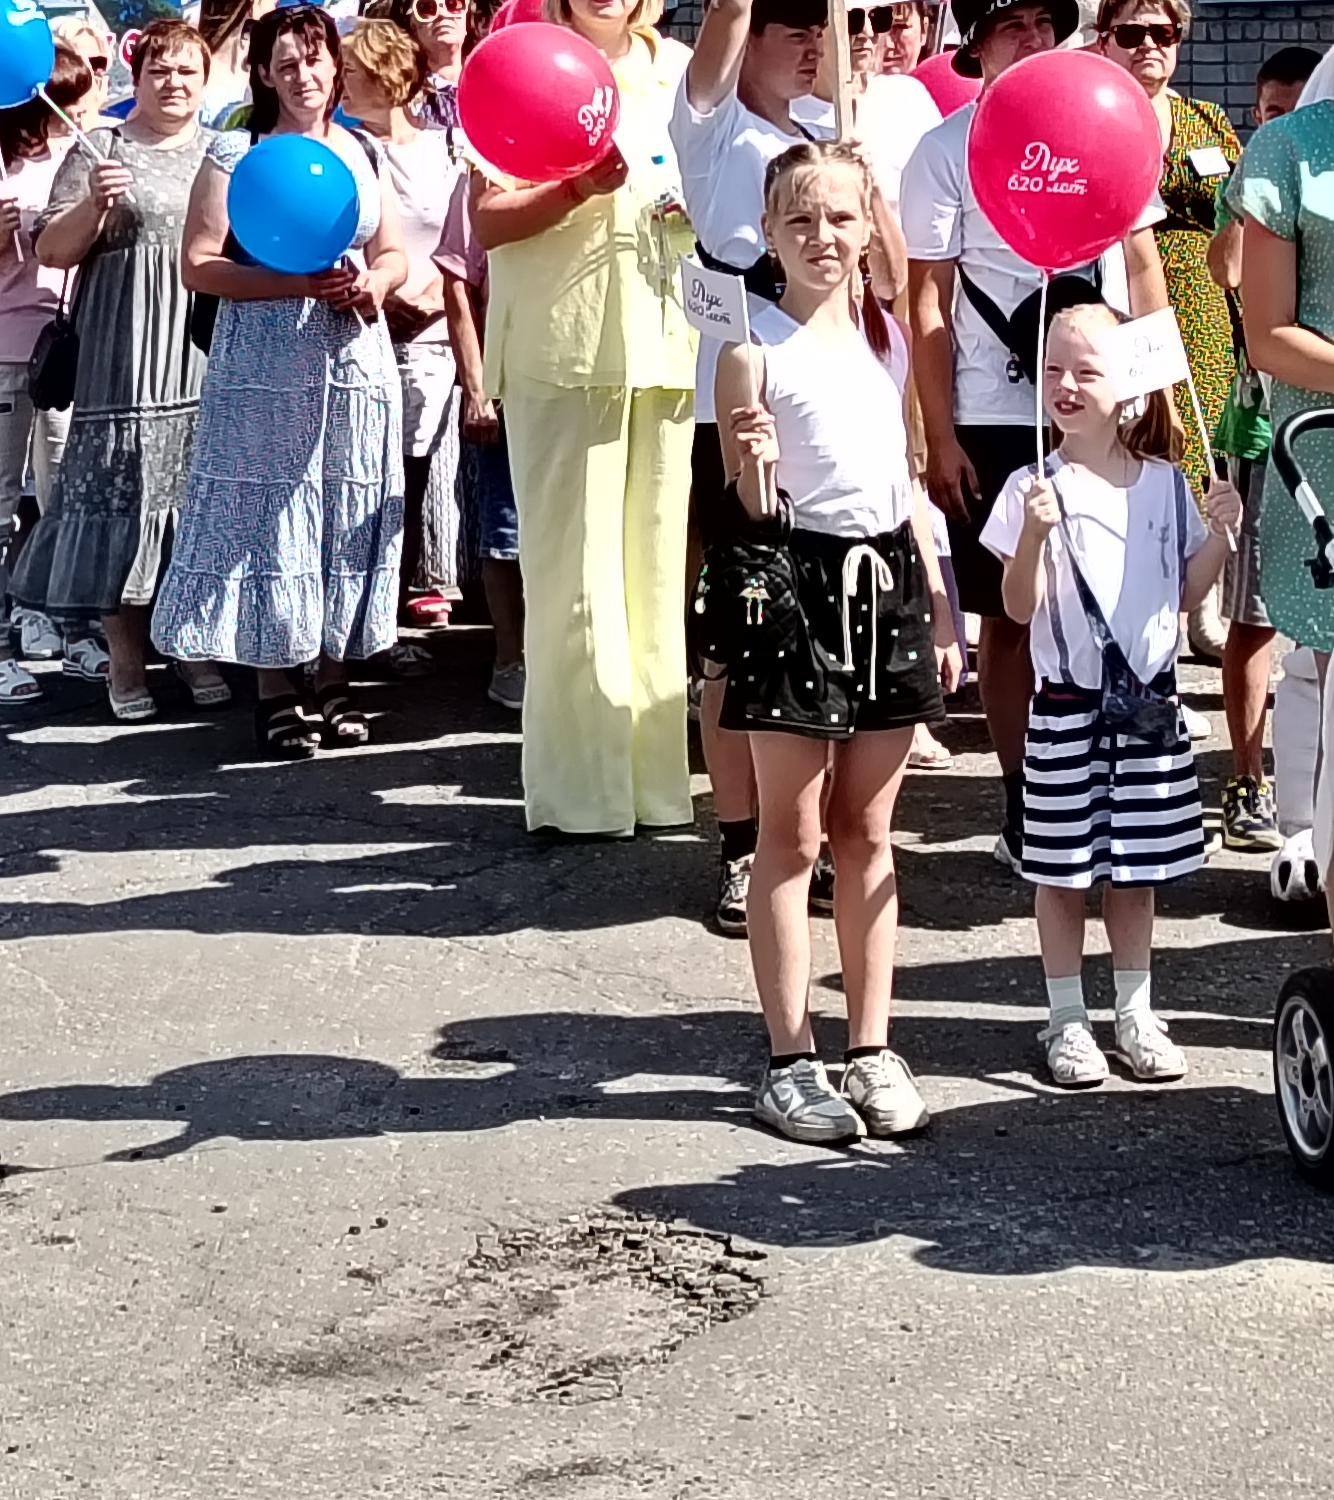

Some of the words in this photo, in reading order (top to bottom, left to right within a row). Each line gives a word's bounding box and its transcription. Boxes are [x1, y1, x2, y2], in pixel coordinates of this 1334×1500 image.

[1020, 141, 1080, 182] Лух
[1007, 174, 1044, 193] 620
[691, 278, 724, 311] Лух
